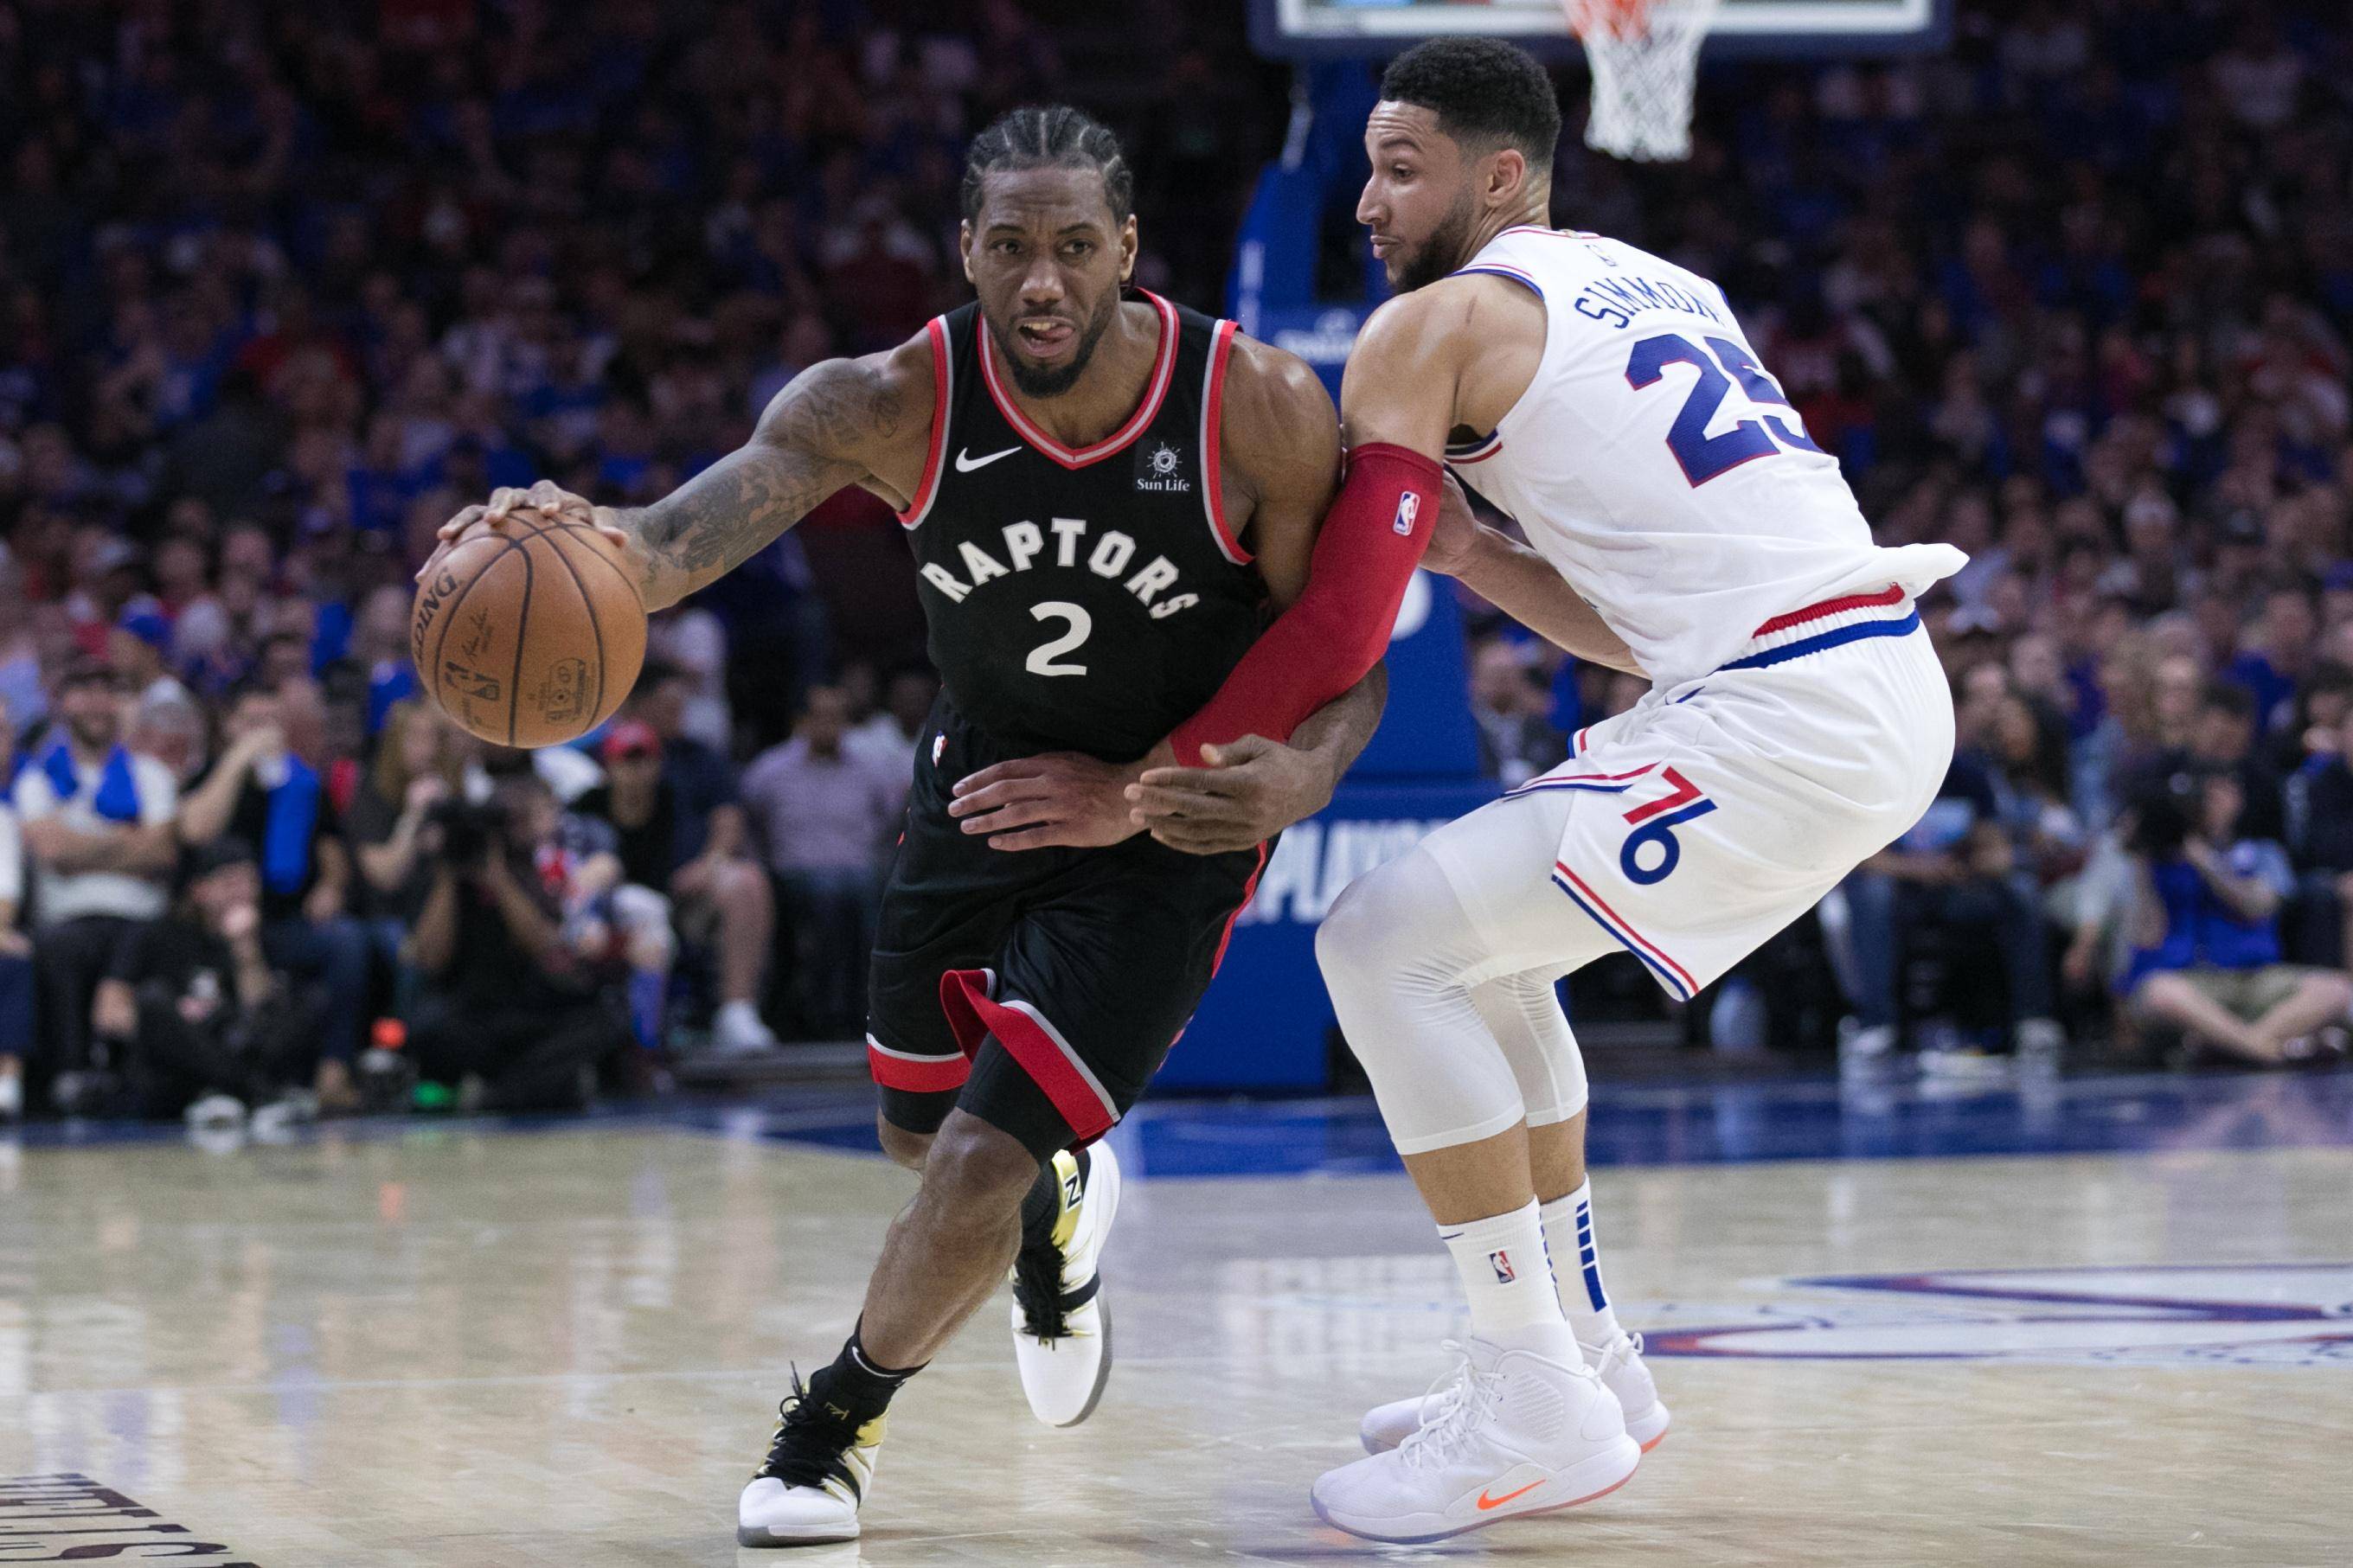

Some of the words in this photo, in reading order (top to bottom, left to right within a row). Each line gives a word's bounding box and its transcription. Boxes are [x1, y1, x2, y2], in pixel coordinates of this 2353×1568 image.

[1574, 277, 1724, 329] SIMMON
[1625, 334, 1824, 489] 25
[1137, 477, 1162, 490] Sun
[1165, 479, 1190, 491] Life
[920, 517, 1200, 619] RAPTORS
[1026, 601, 1092, 676] 2
[1619, 765, 1718, 886] 76
